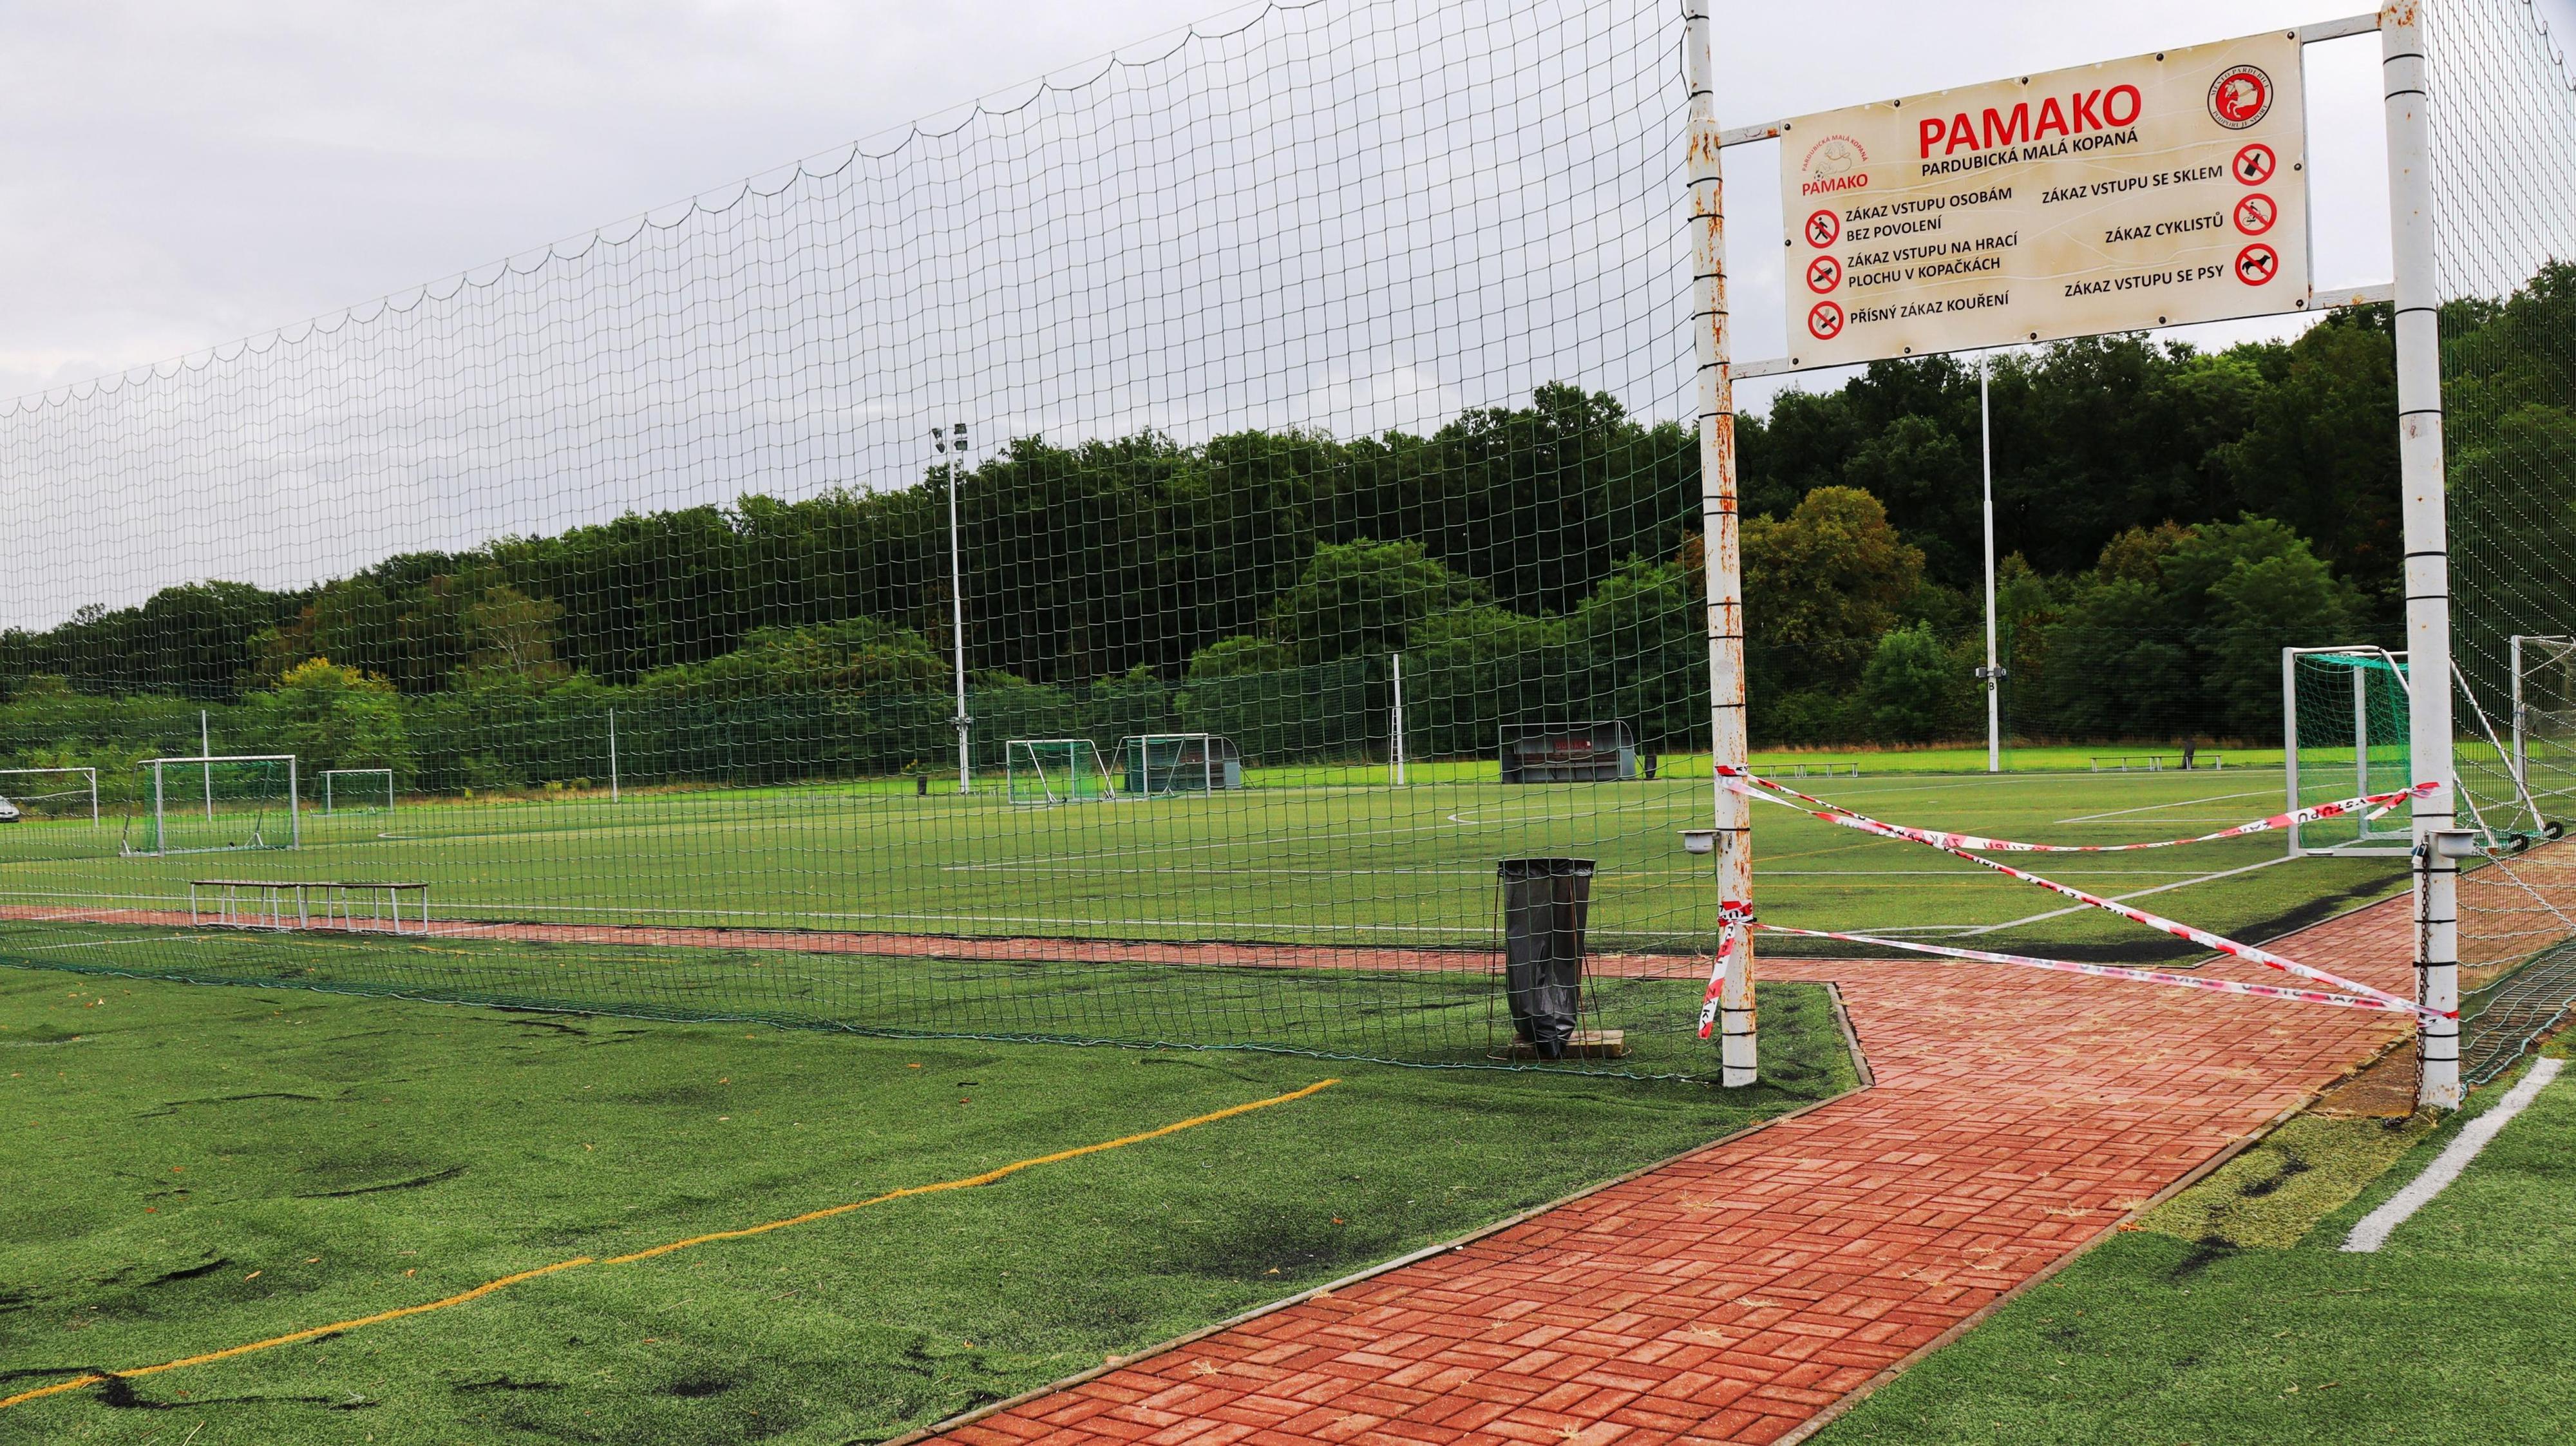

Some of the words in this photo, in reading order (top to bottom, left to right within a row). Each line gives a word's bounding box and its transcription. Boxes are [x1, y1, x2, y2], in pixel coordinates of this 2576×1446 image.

[1920, 84, 2142, 159] PAMAKO
[2250, 104, 2268, 122] SPORT
[1922, 146, 2018, 176] PARDUBICKÁ
[2023, 138, 2069, 161] MALÁ
[2072, 126, 2138, 153] KOPANÁ
[1802, 173, 1868, 196] PAMAKO
[2042, 186, 2087, 204] ZÁKAZ
[2091, 176, 2148, 196] VSTUPU
[2152, 173, 2169, 187] SE
[2173, 165, 2222, 184] SKLEM
[1846, 206, 1888, 222] ZÁKAZ
[1891, 197, 1946, 215] VSTUPU
[1949, 187, 2012, 207] OSOBÁM
[1847, 228, 1870, 242] BEZ
[1874, 214, 1942, 238] POVOLENÍ
[2105, 225, 2152, 243] ZÁKAZ
[2155, 211, 2224, 236] CYKLISTŮ
[1848, 251, 1889, 268] ZÁKAZ
[1893, 243, 1947, 262] VSTUPU
[1951, 241, 1971, 254] NA
[1976, 231, 2018, 251] HRACÍ
[1849, 270, 1901, 288] PLOCHU
[1905, 268, 1915, 280] V
[1918, 257, 2000, 278] KOPAČKÁCH
[2065, 280, 2110, 297] ZÁKAZ
[2114, 272, 2172, 290] VSTUPU
[2177, 269, 2193, 282] SE
[2198, 264, 2224, 280] PSY
[1850, 304, 1897, 324] PŘÍSNÝ
[1900, 301, 1943, 318] ZÁKAZ
[1947, 290, 2009, 312] KOUŘENÍ
